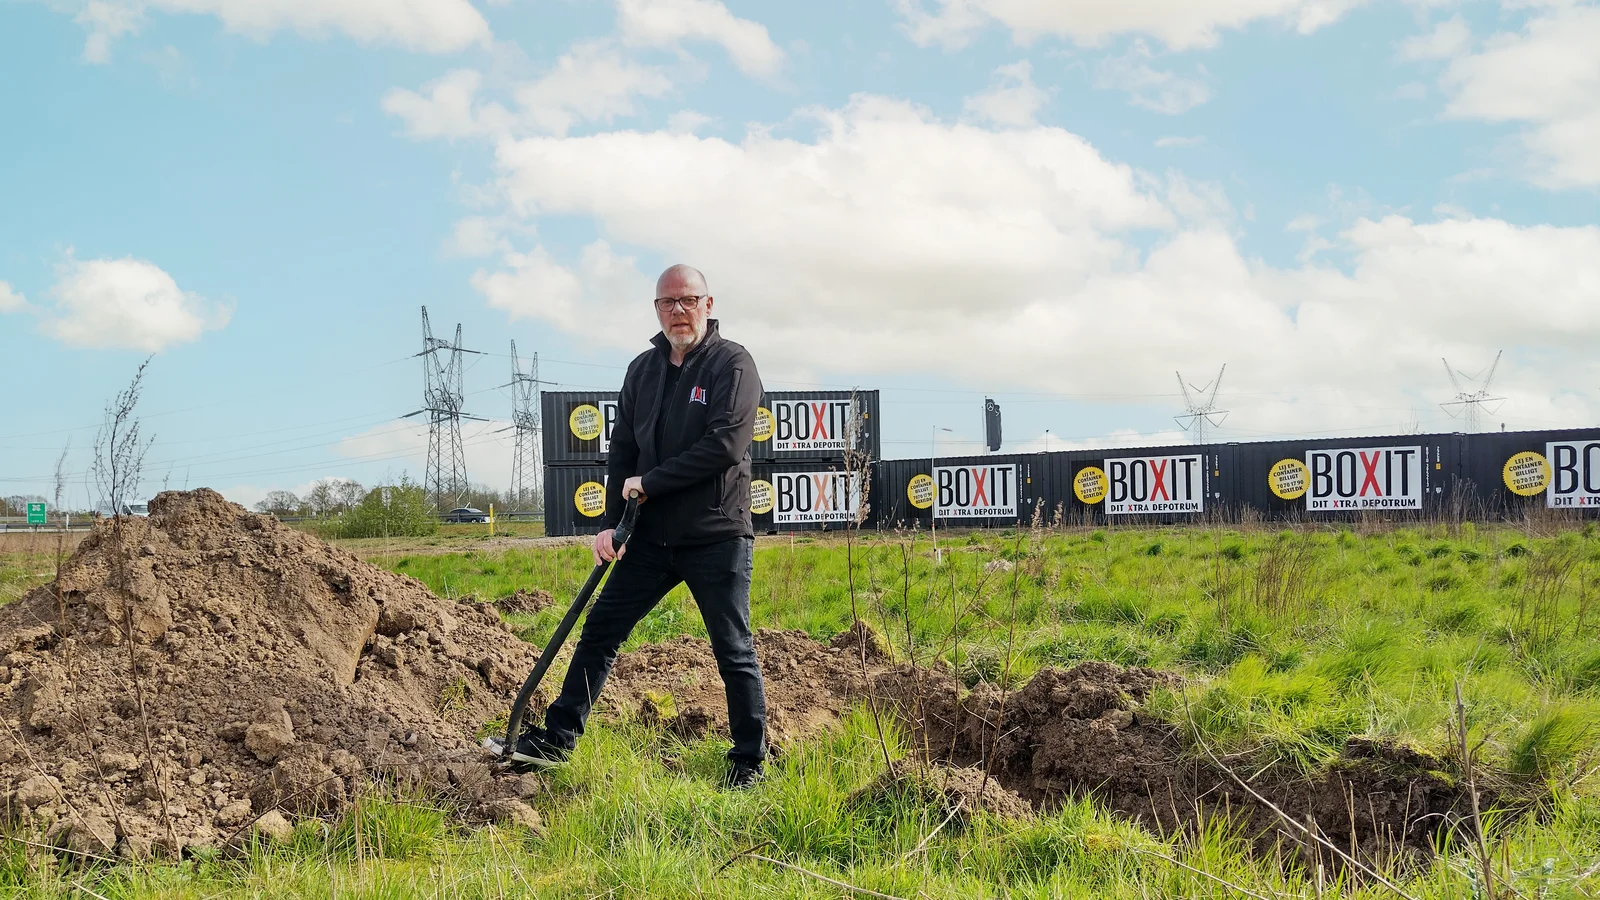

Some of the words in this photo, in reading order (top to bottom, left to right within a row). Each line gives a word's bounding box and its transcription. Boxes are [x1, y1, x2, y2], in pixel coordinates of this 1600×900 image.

[776, 402, 850, 440] BOXIT
[1508, 460, 1543, 471] CONTAINER
[1273, 467, 1303, 477] CONTAINER
[1312, 449, 1415, 497] BOXIT
[1515, 468, 1538, 476] BILLIGT
[1110, 458, 1197, 502] BOXIT
[938, 467, 1012, 507] BOXIT
[777, 474, 854, 513] BOXIT
[1313, 500, 1328, 508] DIT
[1333, 500, 1358, 508] XTRA
[1362, 499, 1416, 507] DEPOTRUM
[1554, 497, 1573, 505] DIT
[1579, 496, 1600, 505] XTR
[1110, 504, 1124, 512] DIT
[1128, 504, 1149, 512] XTRA
[1152, 503, 1198, 511] DEPOTRUM
